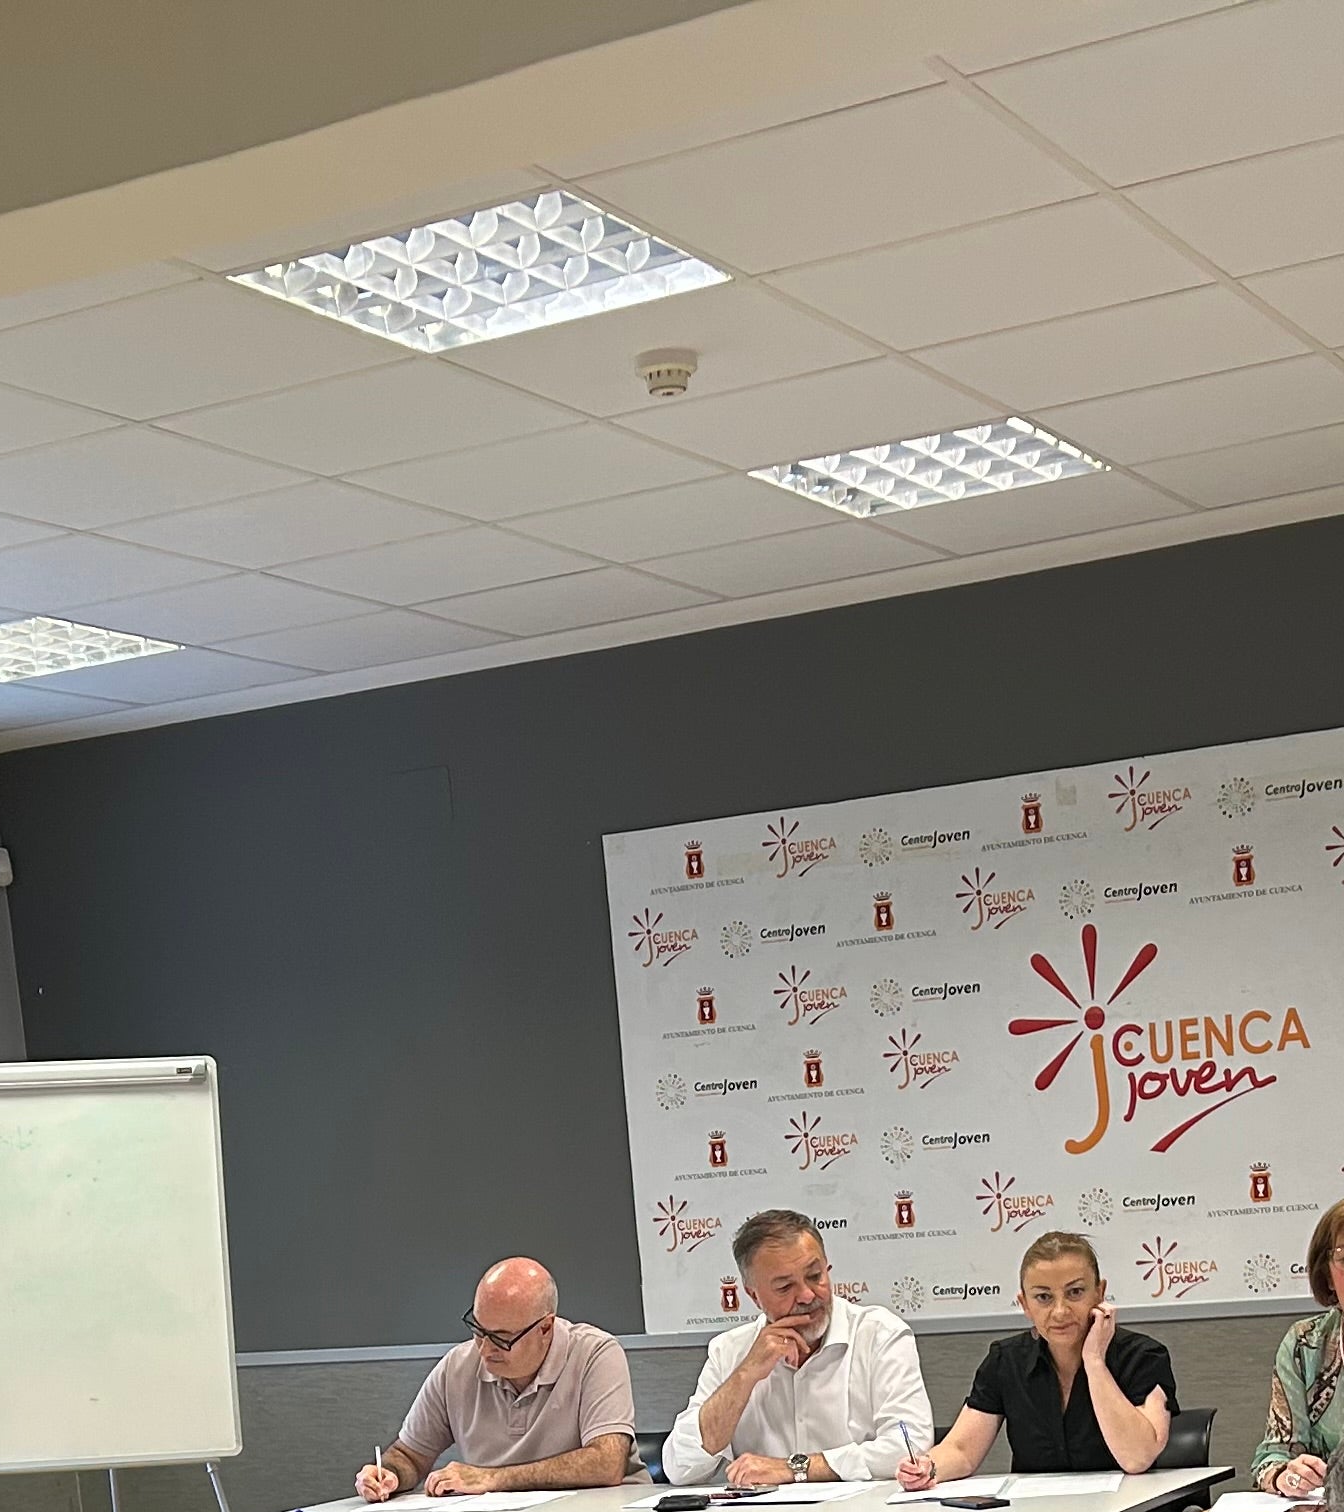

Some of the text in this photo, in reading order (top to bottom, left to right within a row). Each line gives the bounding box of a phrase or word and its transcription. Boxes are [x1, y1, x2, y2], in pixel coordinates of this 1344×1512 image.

[1265, 778, 1343, 798] CentroJoven
[1137, 788, 1192, 806] CUENCA
[1140, 803, 1182, 821] joven
[788, 837, 836, 854] CUENCA
[901, 830, 970, 848] CentroJoven
[981, 837, 1042, 852] AYUNTAMIENTO
[1056, 832, 1088, 843] CUENCA
[791, 852, 828, 869] joven
[650, 882, 704, 896] AYUNTAMIENTO
[716, 878, 744, 888] CUENCA
[1104, 882, 1178, 900] CentroJoven
[1188, 889, 1254, 904] AYUNTAMIENTO
[1269, 884, 1303, 896] CUENCA
[984, 889, 1035, 906] CUENCA
[987, 904, 1026, 921] joven
[653, 929, 698, 944] CUENCA
[760, 924, 825, 941] CentroJoven
[836, 934, 893, 948] AYUNTAMIENTO
[906, 930, 936, 940] CUENCA
[656, 942, 691, 959] joven
[799, 988, 847, 1002] CUENCA
[912, 982, 980, 1000] CentroJoven
[802, 1000, 840, 1017] joven
[662, 1027, 716, 1040] AYUNTAMIENTO
[728, 1024, 756, 1033] CUENCA
[1112, 1008, 1311, 1066] CUENCA
[910, 1051, 960, 1066] CUENCA
[913, 1065, 951, 1080] joven
[694, 1079, 757, 1095] CentroJoven
[767, 1091, 823, 1102] AYUNTAMIENTO
[836, 1088, 864, 1097] CUENCA
[1124, 1061, 1276, 1122] joven
[810, 1133, 858, 1148] CUENCA
[922, 1132, 990, 1149] CentroJoven
[814, 1146, 850, 1162] joven
[674, 1170, 728, 1181] AYUNTAMIENTO
[740, 1168, 768, 1177] CUENCA
[1004, 1195, 1054, 1209] CUENCA
[1123, 1194, 1195, 1211] CentroJoven
[1207, 1206, 1271, 1218] AYUNTAMIENTO
[1286, 1203, 1319, 1213] CUENCA
[677, 1218, 722, 1231] CUENCA
[1006, 1208, 1045, 1224] joven
[680, 1229, 715, 1244] joven
[858, 1231, 914, 1242] AYUNTAMIENTO
[927, 1229, 957, 1238] CUENCA
[1165, 1260, 1217, 1275] CUENCA
[1168, 1273, 1209, 1290] joven
[933, 1284, 1000, 1299] CentroJoven
[686, 1314, 739, 1325] AYUNTAMIENTO
